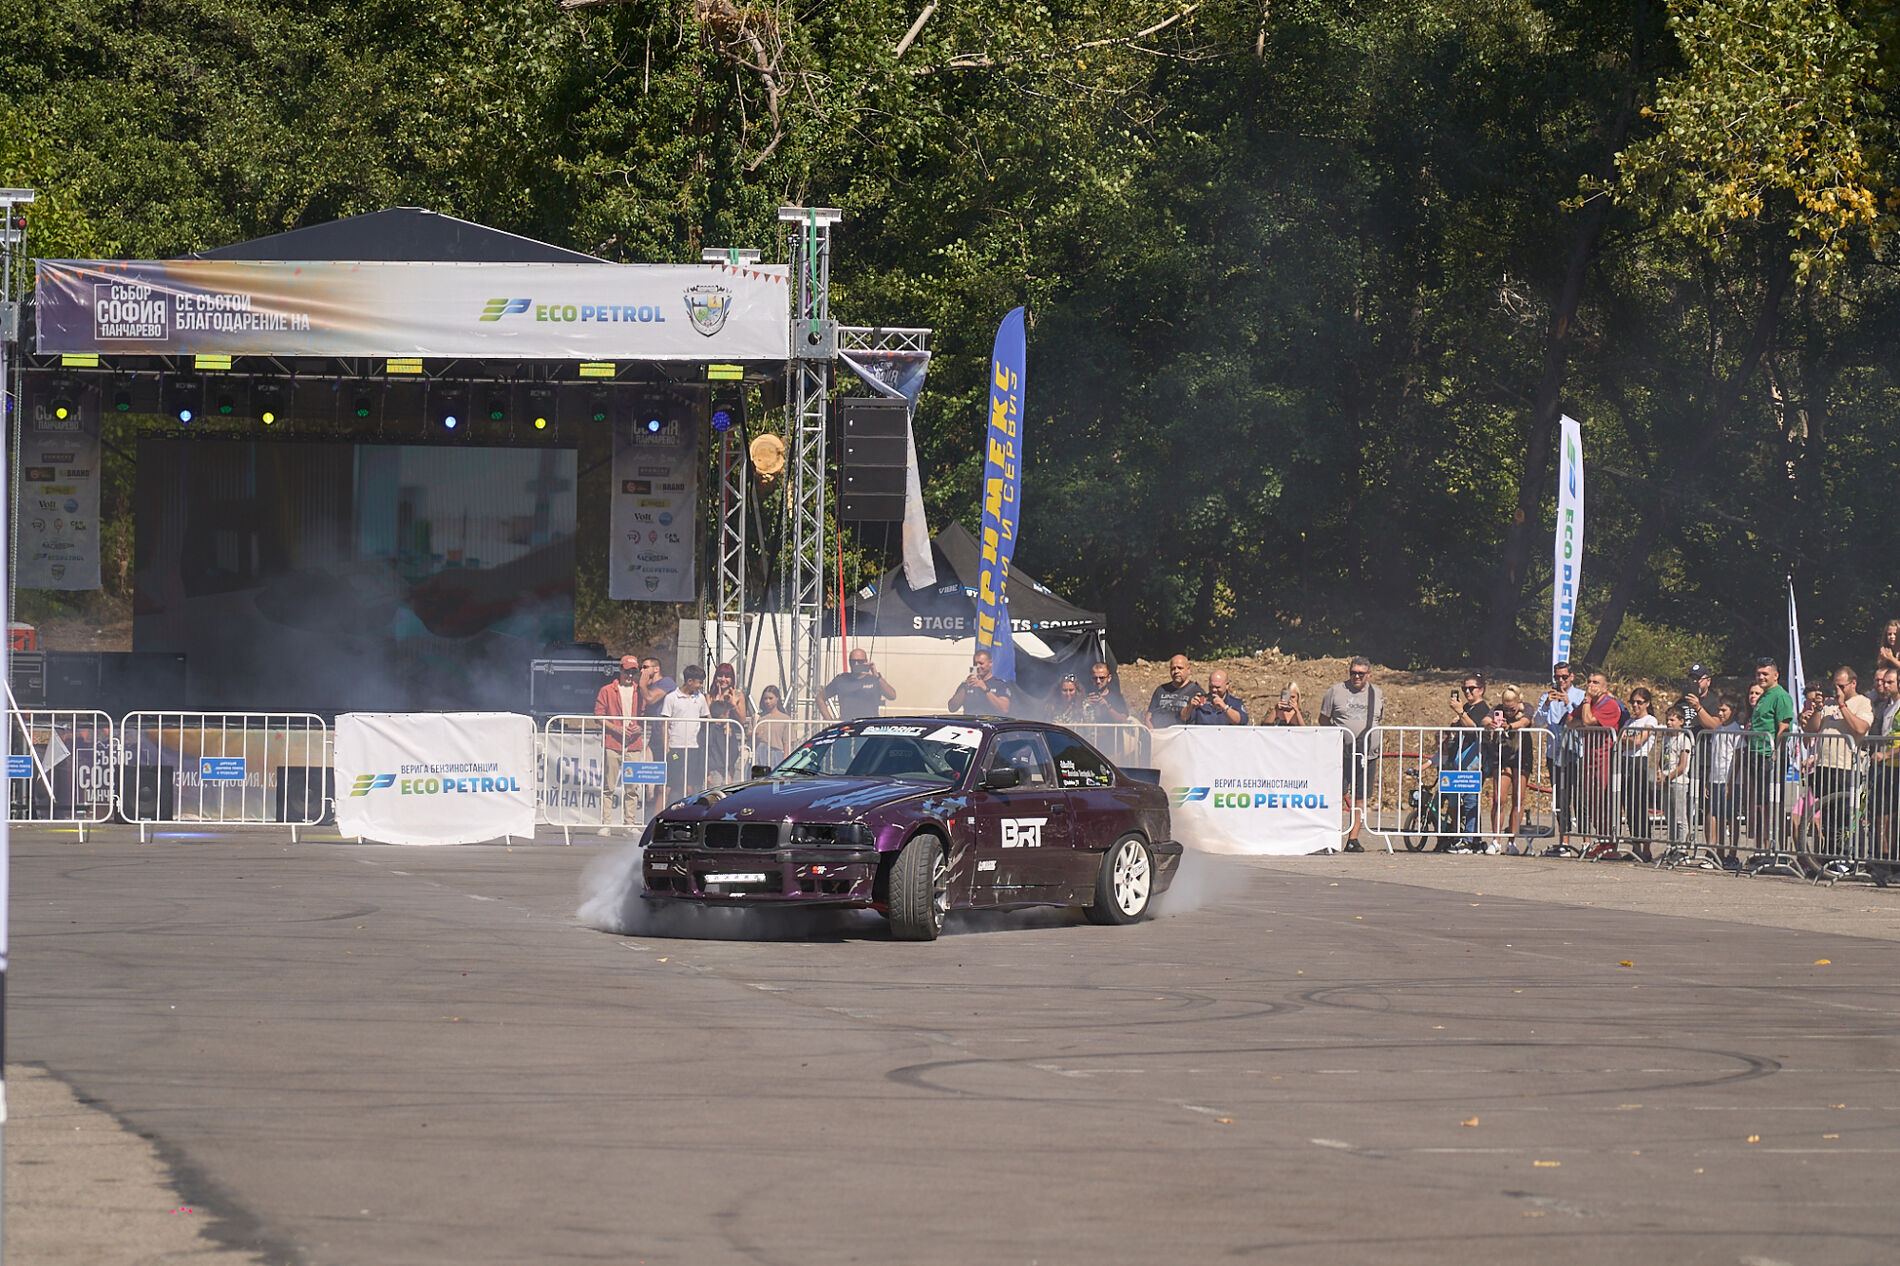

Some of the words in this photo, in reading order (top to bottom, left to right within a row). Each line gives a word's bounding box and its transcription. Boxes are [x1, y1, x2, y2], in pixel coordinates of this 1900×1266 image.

[111, 286, 151, 301] СЪБОР
[97, 300, 166, 324] СОФИЯ
[176, 295, 193, 311] СЕ
[197, 294, 251, 312] СЪСТОИ
[176, 312, 287, 332] БЛАГОДАРЕНИЕ
[291, 313, 310, 330] НА
[536, 305, 577, 322] ECO
[581, 305, 665, 323] PETROL
[101, 323, 162, 337] ПАНЧАРЕВО
[1564, 508, 1574, 559] ECO
[913, 616, 964, 630] STAGE
[401, 764, 429, 774] ВЕРИГА
[430, 762, 499, 774] БЕНЗИНОСТАНЦИИ
[401, 778, 439, 795] ECO
[443, 776, 521, 794] PETROL
[1214, 779, 1241, 788] ВЕРИГА
[1243, 779, 1308, 789] БЕНЗИНОСТАНЦИИ
[1214, 793, 1251, 808] ECO
[1254, 794, 1329, 809] PETROL
[1001, 818, 1048, 848] BRT
